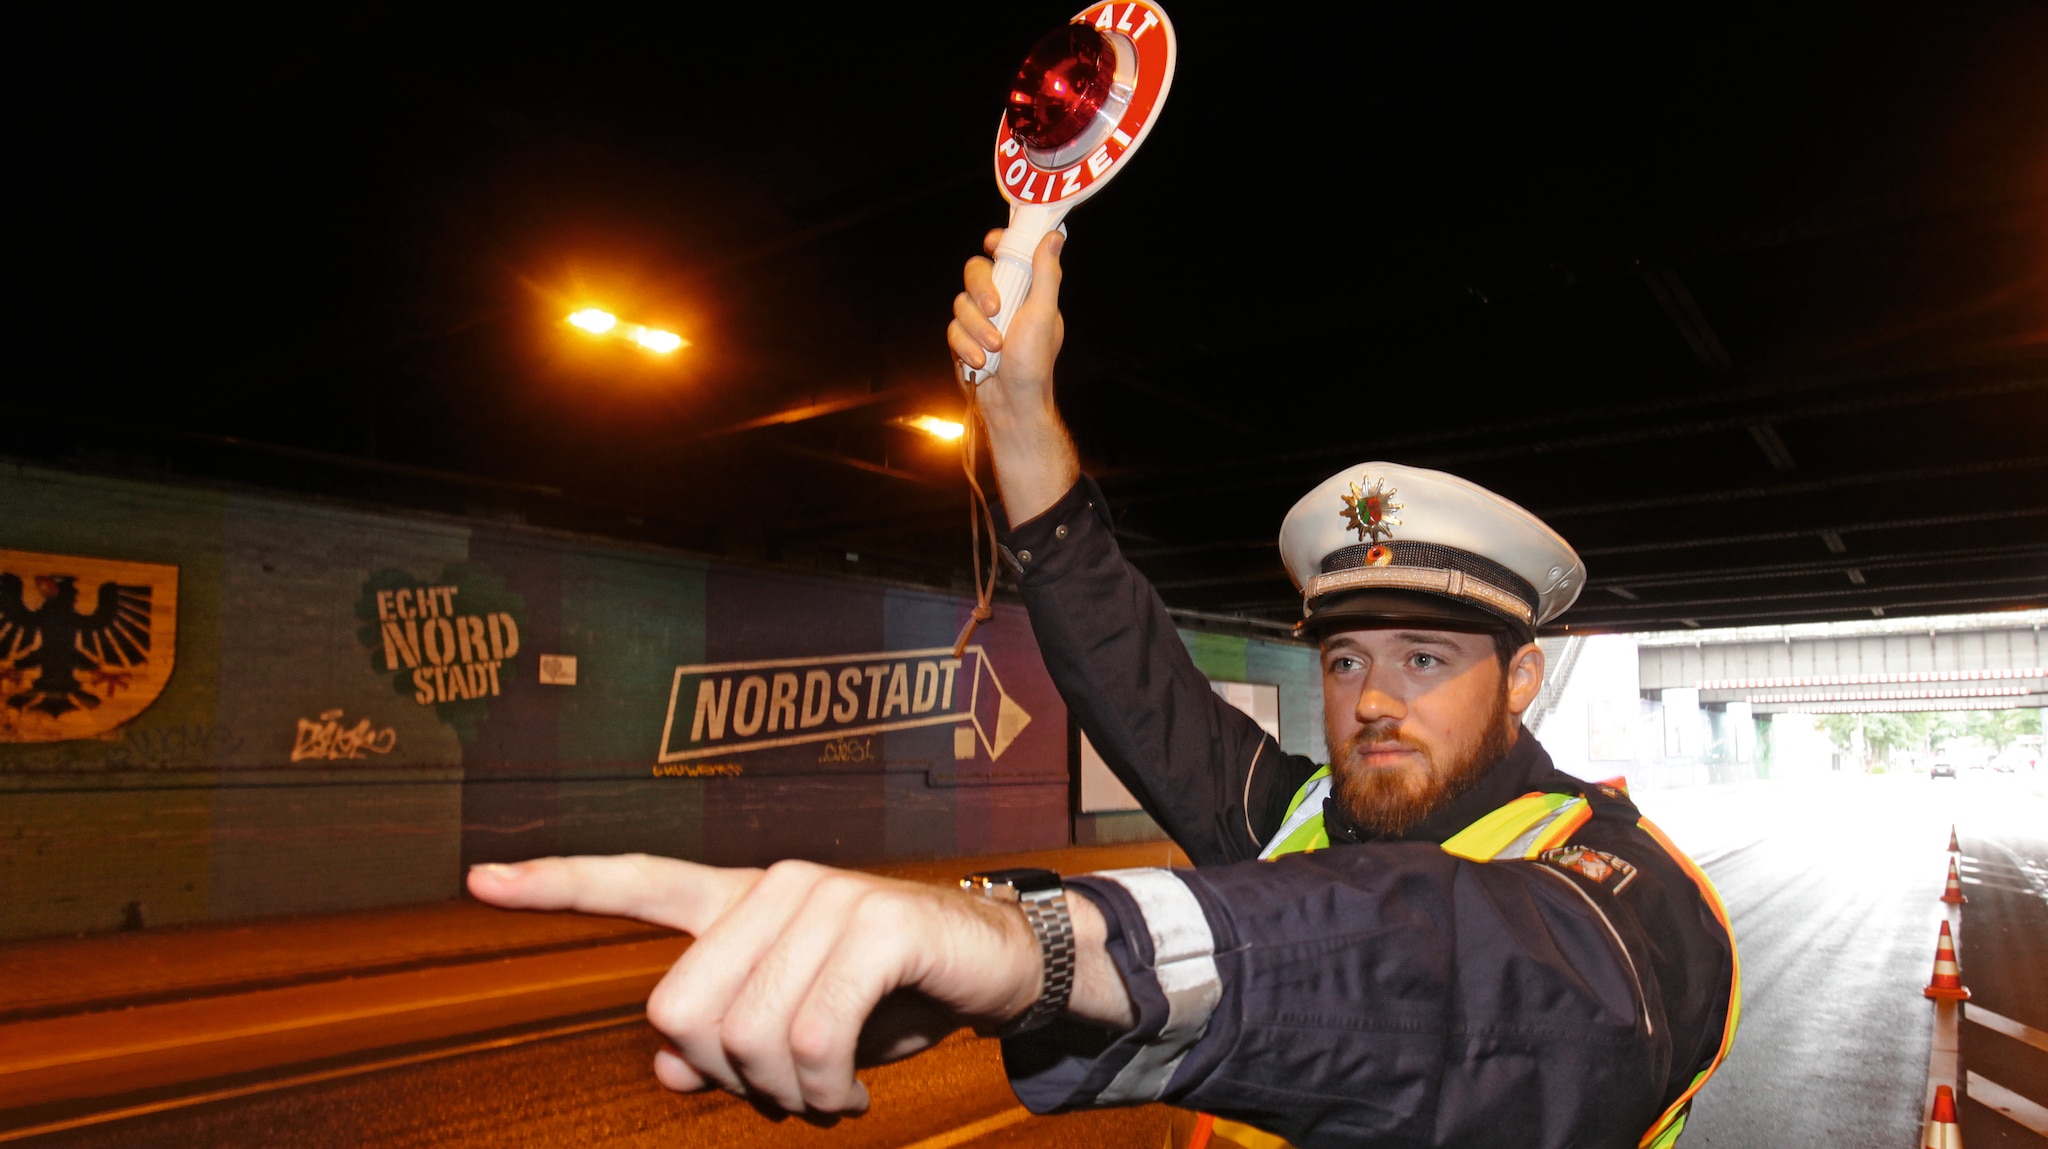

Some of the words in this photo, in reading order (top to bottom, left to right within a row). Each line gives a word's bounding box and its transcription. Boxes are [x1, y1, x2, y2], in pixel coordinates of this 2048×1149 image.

[1081, 2, 1159, 40] ALT
[1000, 128, 1133, 203] POLIZEI
[376, 585, 459, 622] ECHT
[381, 611, 520, 671] NORD
[412, 659, 502, 705] STADT
[689, 658, 962, 743] NORDSTADT
